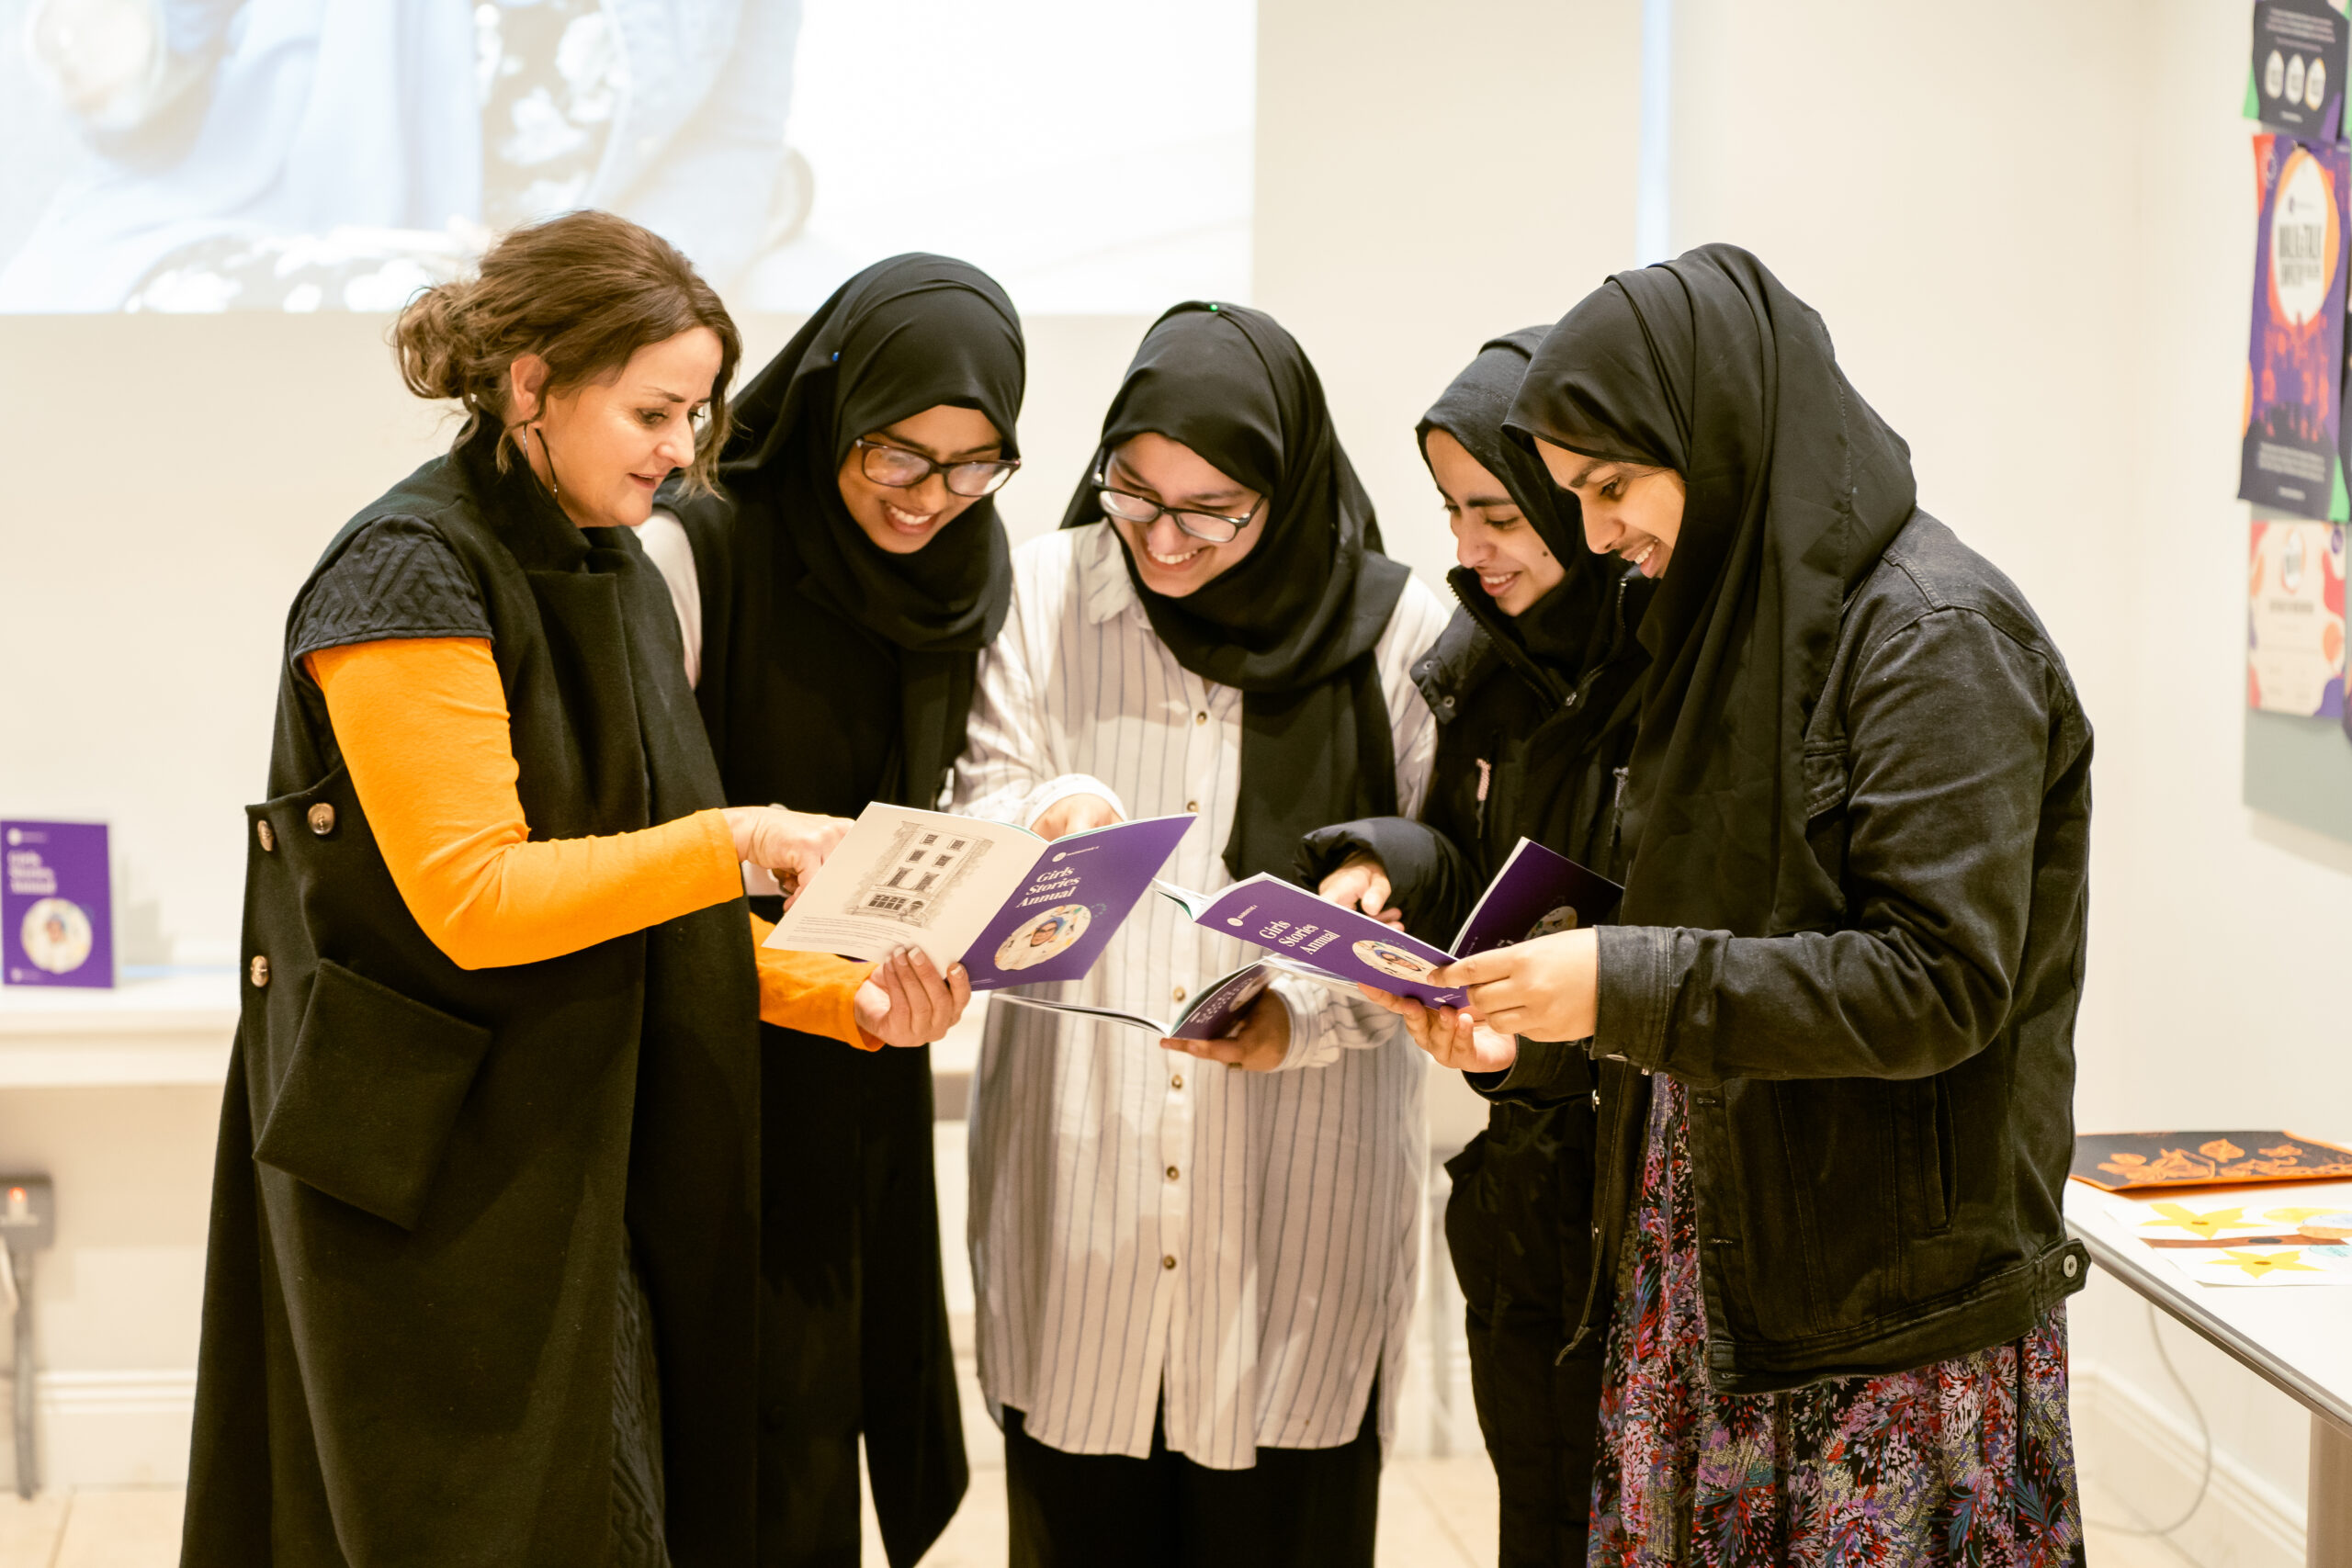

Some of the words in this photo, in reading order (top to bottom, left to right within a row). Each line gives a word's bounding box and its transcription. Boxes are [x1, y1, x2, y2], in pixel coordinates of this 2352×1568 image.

[1036, 866, 1075, 883] Girls
[1014, 886, 1077, 908] Annual
[1025, 877, 1081, 896] Stories
[1259, 919, 1292, 940] Girls
[1278, 923, 1319, 947] Stories
[1299, 929, 1341, 955] Annual
